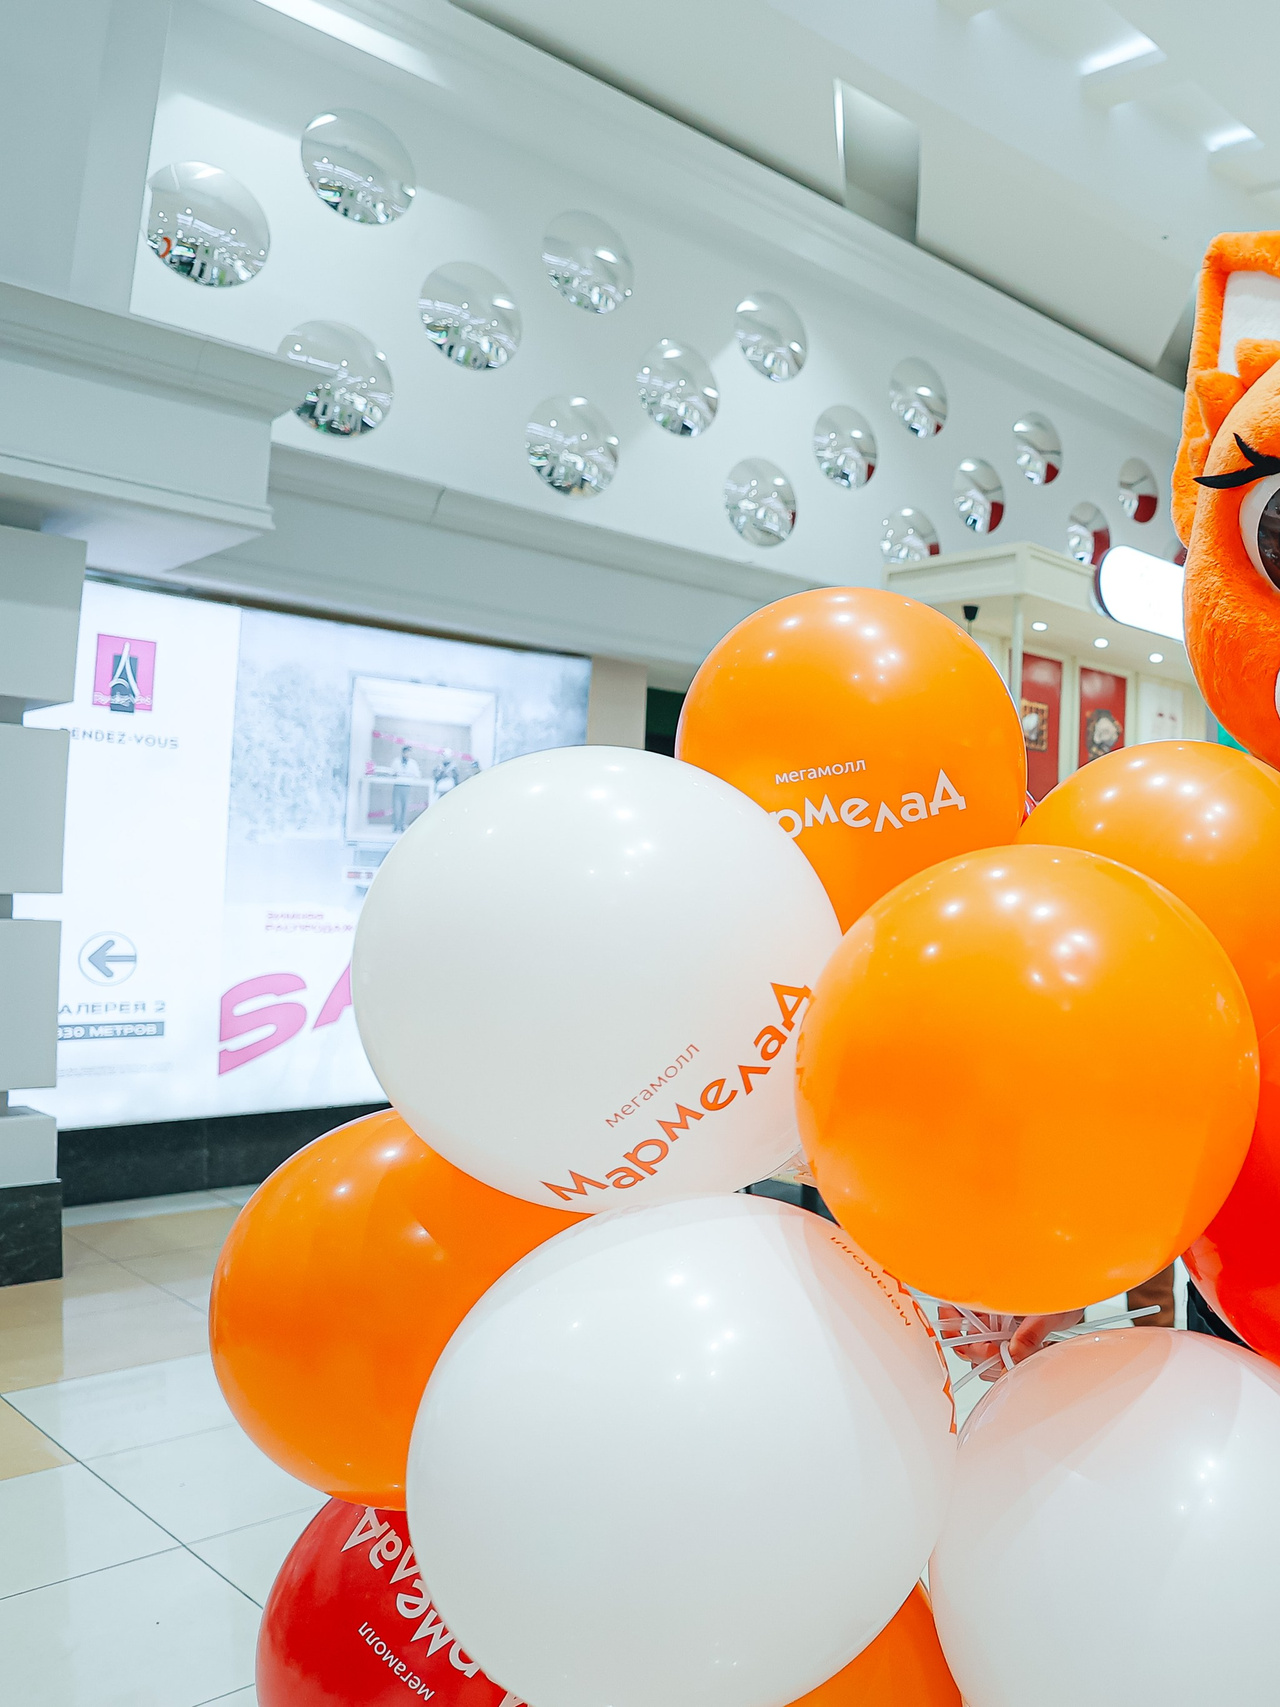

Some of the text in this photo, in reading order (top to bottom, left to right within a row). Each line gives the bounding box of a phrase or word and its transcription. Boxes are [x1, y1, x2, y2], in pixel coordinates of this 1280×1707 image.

[60, 727, 180, 750] ENDEZ-VOUS
[774, 758, 867, 785] мегамолл
[57, 1002, 147, 1015] АЛЕРЕЯ
[89, 1023, 158, 1038] МЕТРОВ
[604, 1043, 700, 1128] мегамолл
[357, 1620, 436, 1701] мегамолл
